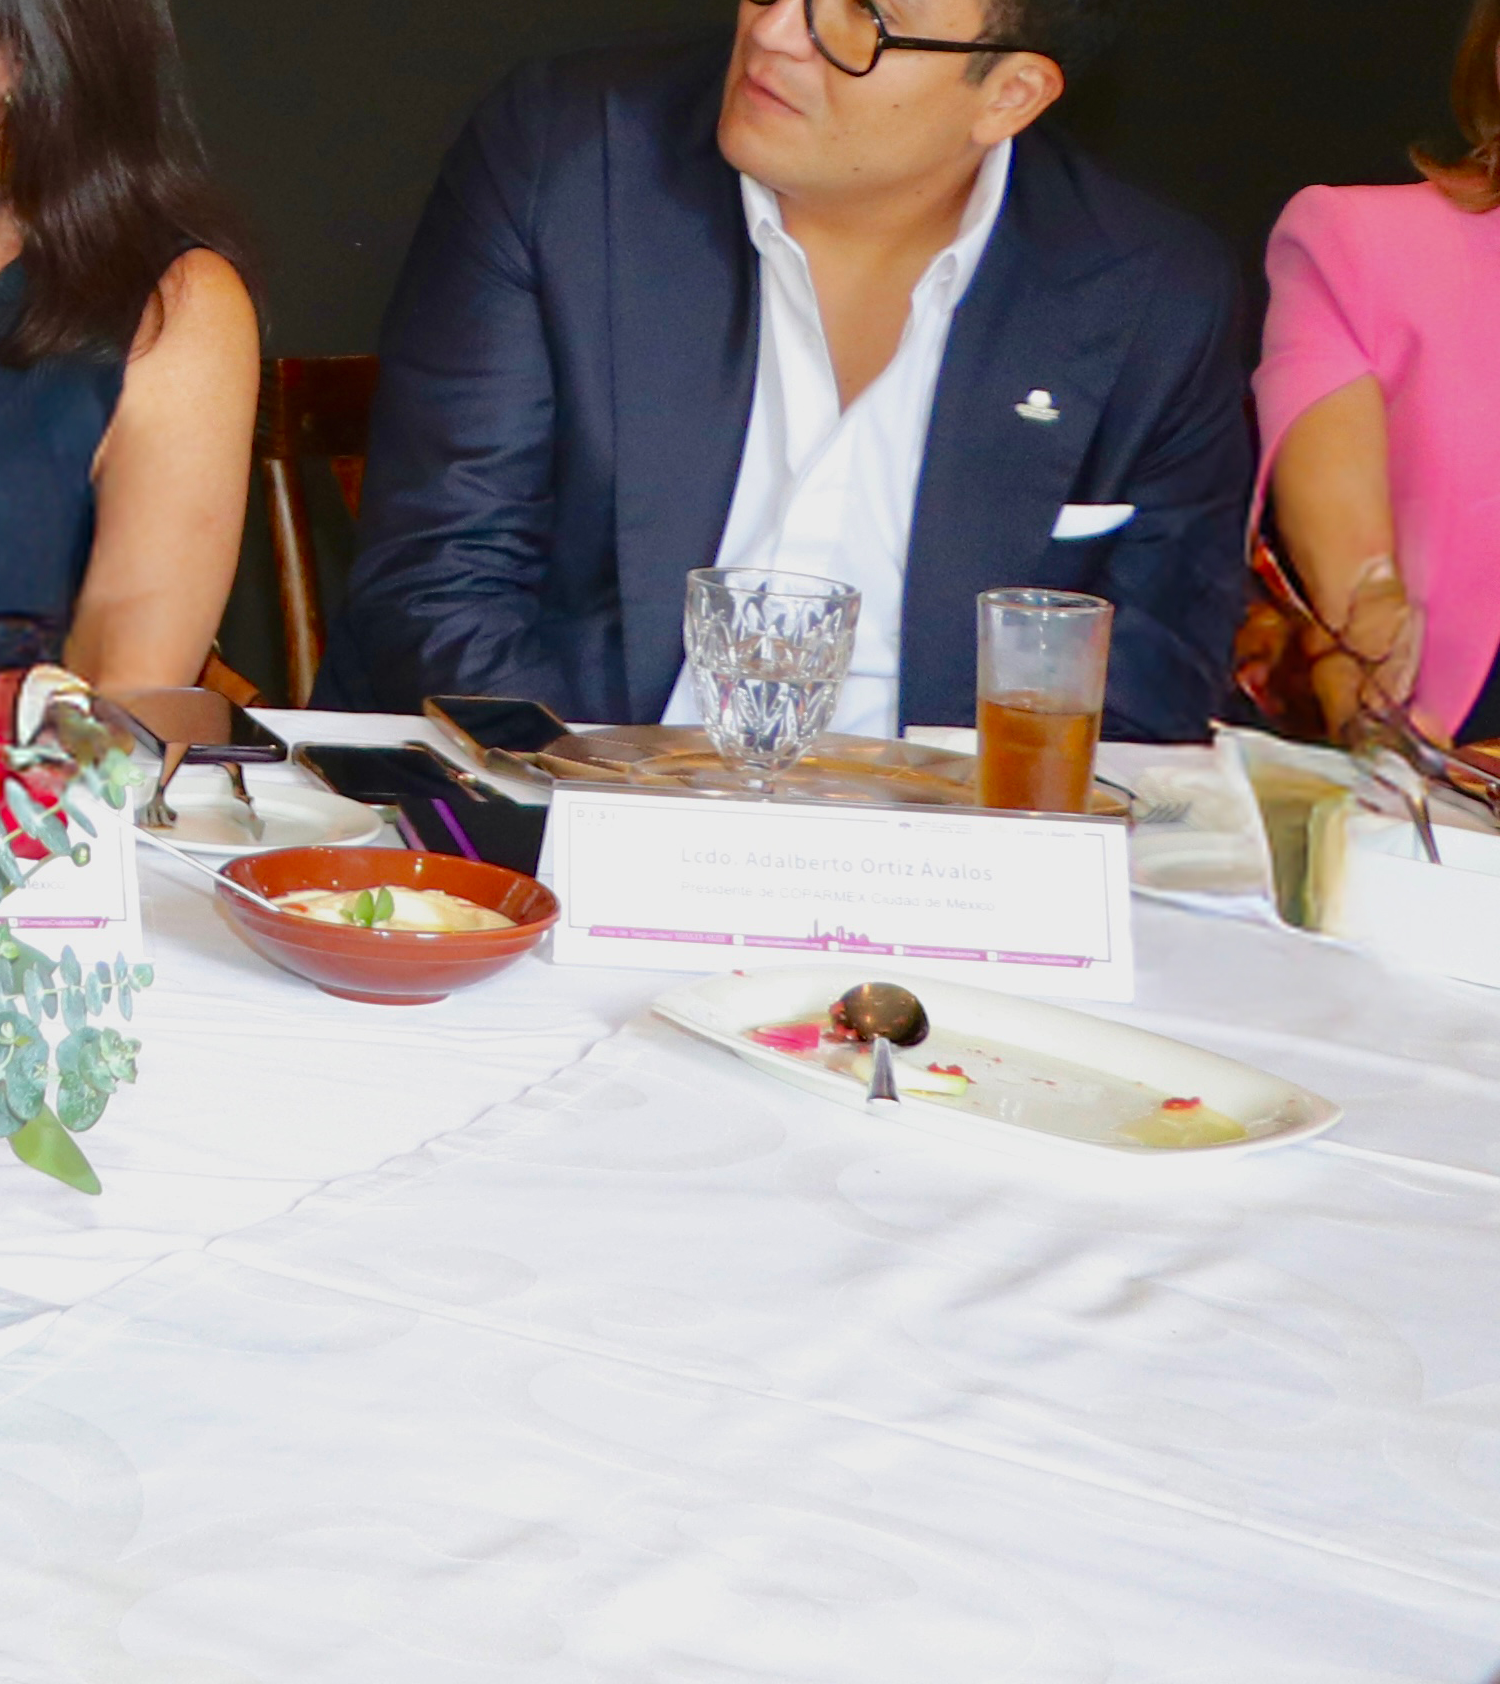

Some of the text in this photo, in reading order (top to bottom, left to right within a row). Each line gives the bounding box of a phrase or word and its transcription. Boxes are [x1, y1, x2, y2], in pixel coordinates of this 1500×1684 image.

[681, 847, 994, 882] Lcdo. Adalberto Ortiz Ávalos
